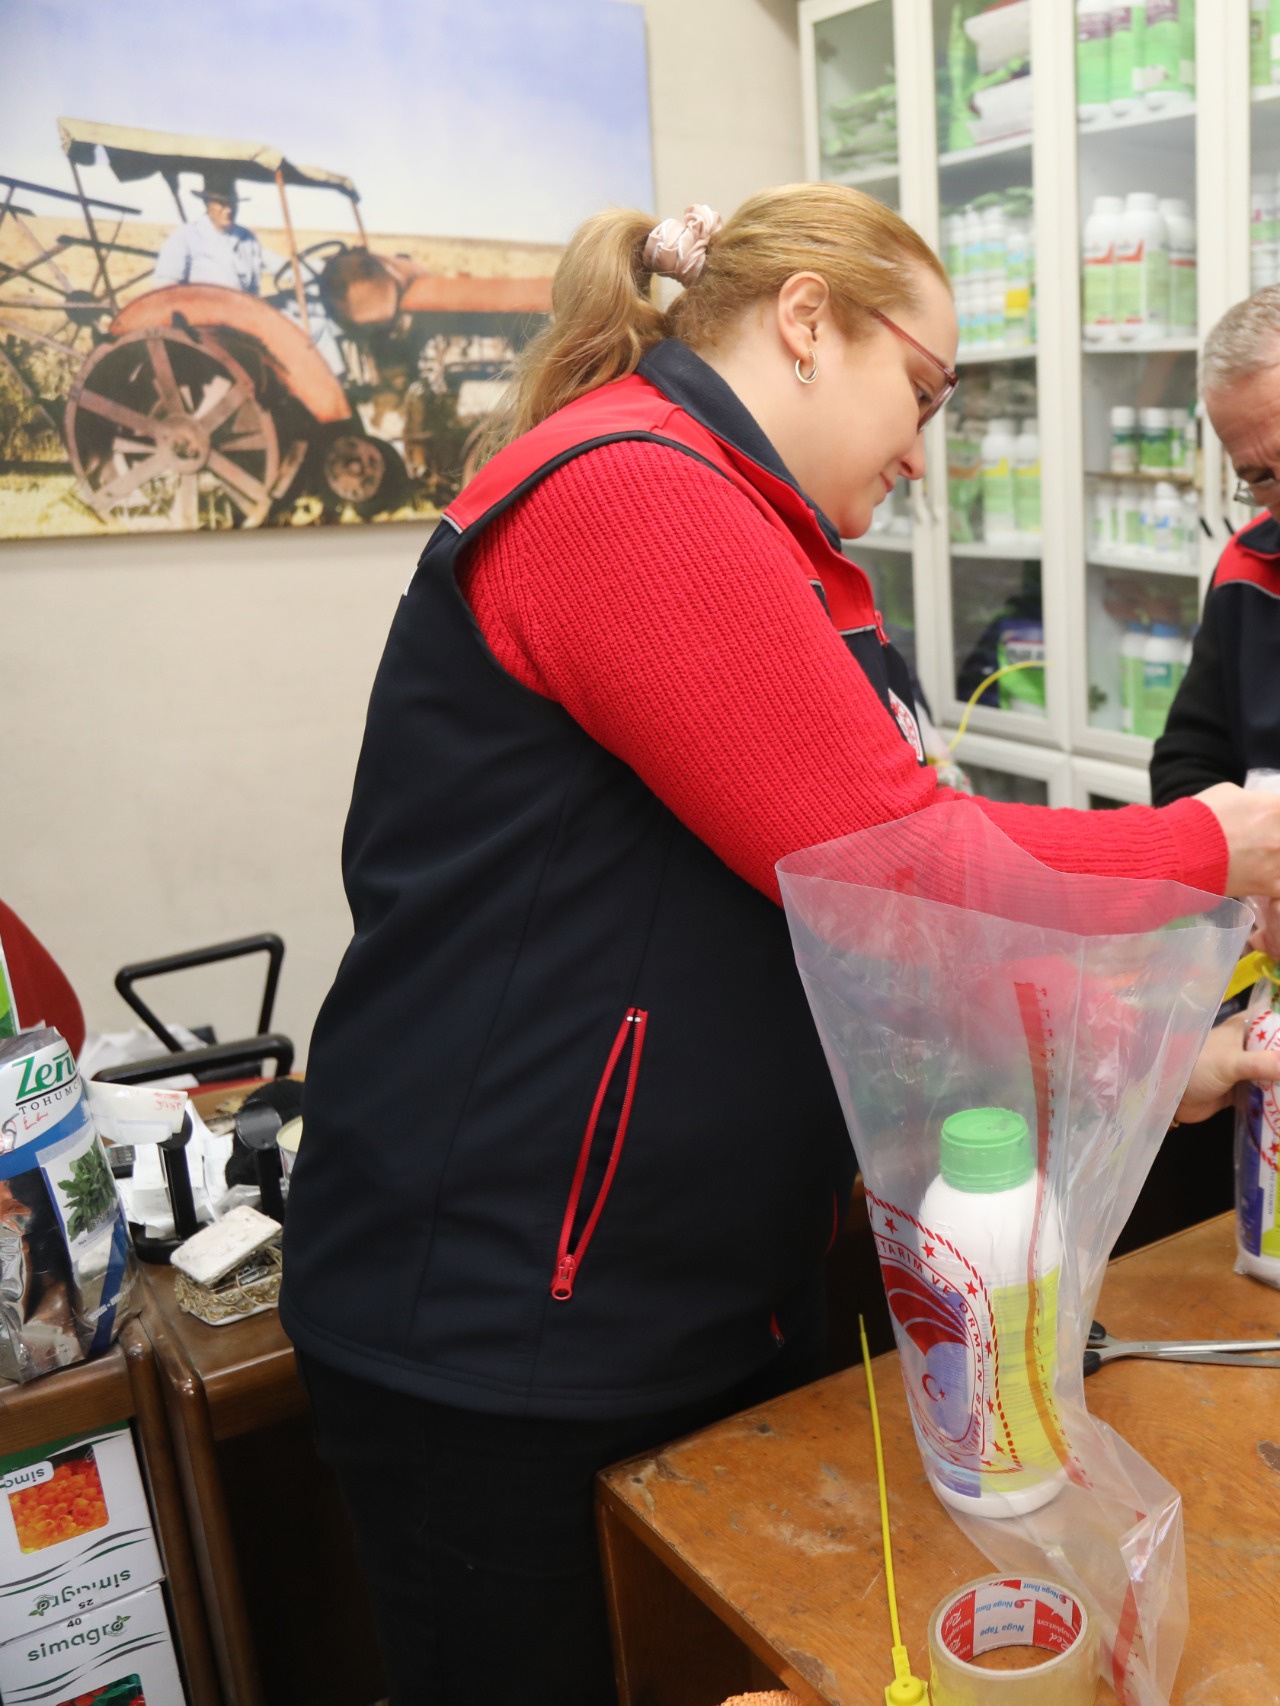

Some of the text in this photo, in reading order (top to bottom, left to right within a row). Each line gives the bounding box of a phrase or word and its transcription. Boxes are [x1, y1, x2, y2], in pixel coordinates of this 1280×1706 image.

[881, 1240, 924, 1273] TARIM
[931, 1273, 952, 1298] VE
[958, 1301, 983, 1383] ORMAN
[1041, 1585, 1060, 1599] Nuga
[78, 1598, 94, 1610] 25
[975, 1603, 992, 1614] Bant
[993, 1600, 1013, 1609] Nuga
[66, 1617, 82, 1628] 40
[980, 1623, 1025, 1636] Nuga Tape
[28, 1616, 127, 1662] simagro
